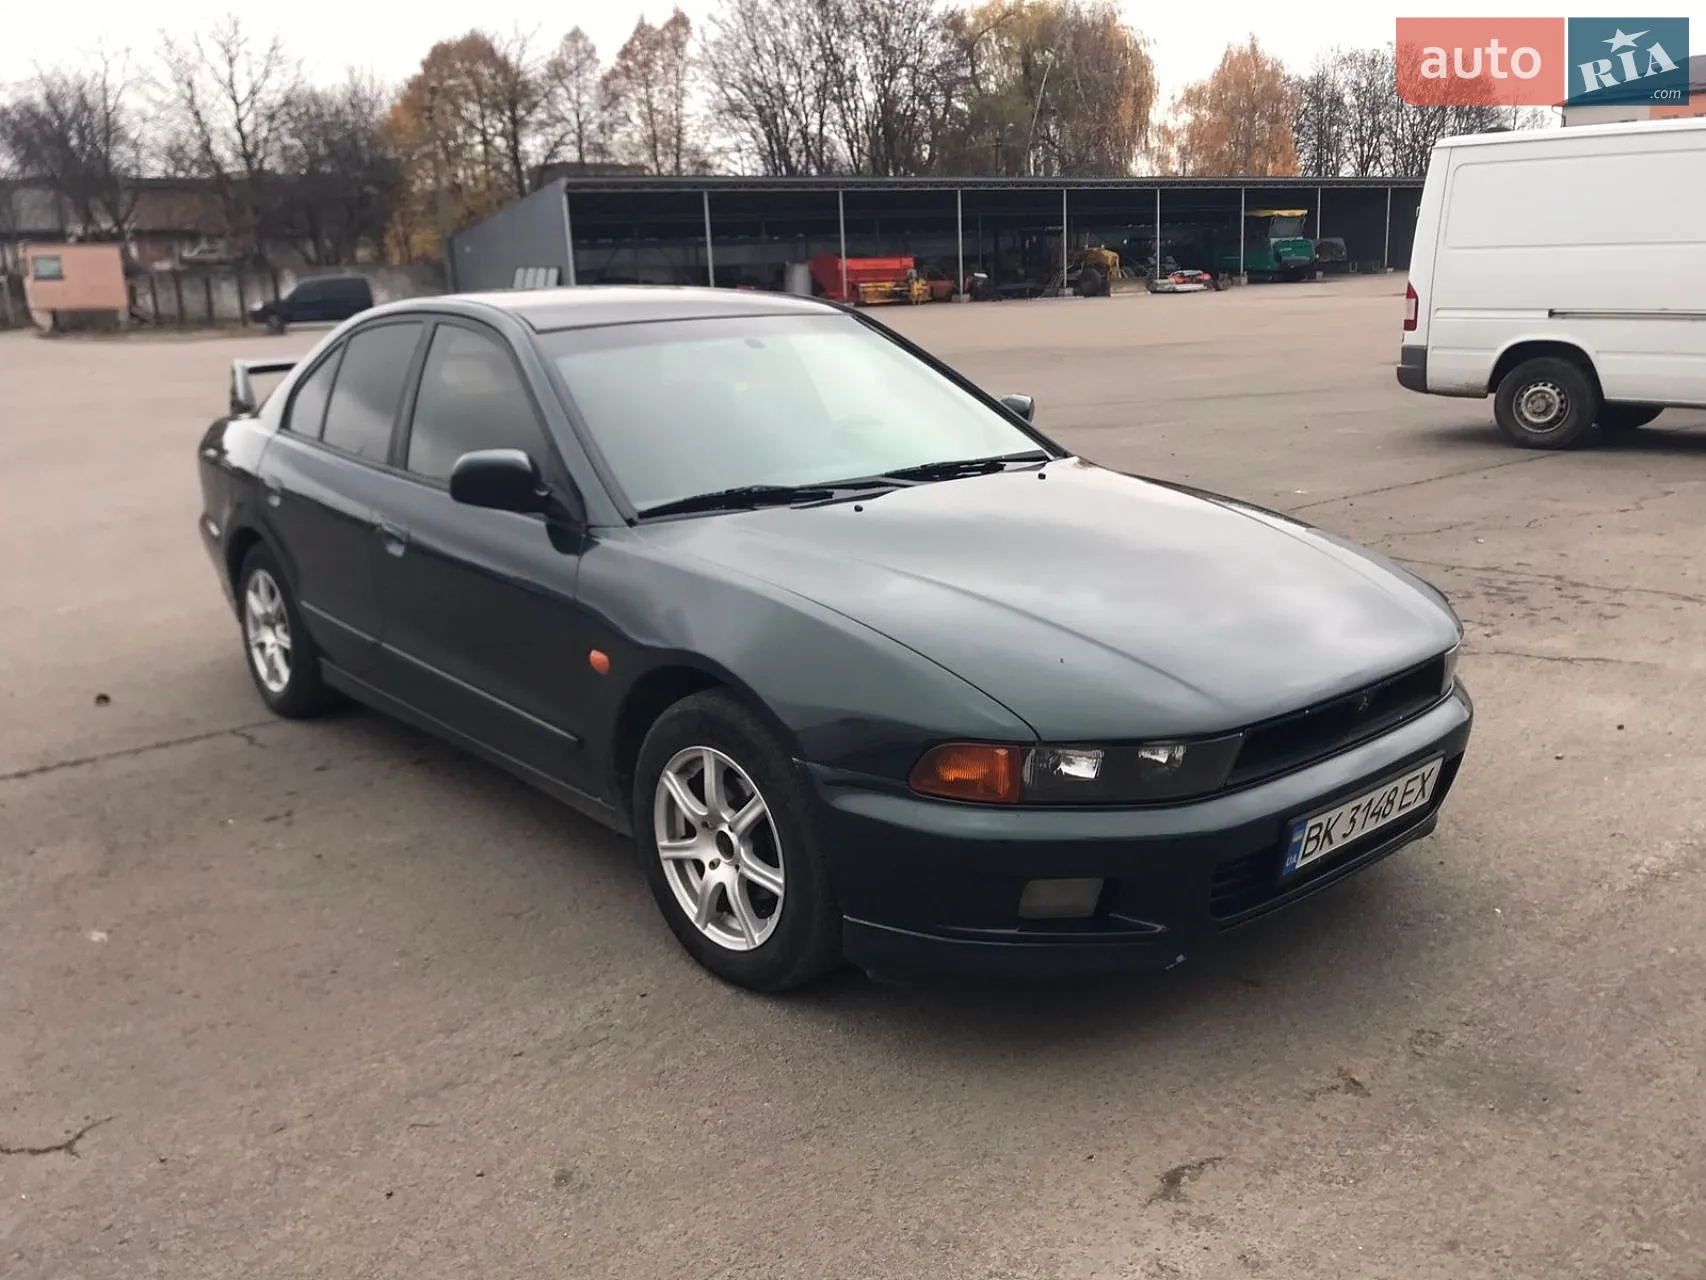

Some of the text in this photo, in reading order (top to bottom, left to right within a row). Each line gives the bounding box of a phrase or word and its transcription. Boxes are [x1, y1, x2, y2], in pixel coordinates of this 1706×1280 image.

[1301, 767, 1435, 860] BK 3148 EX
